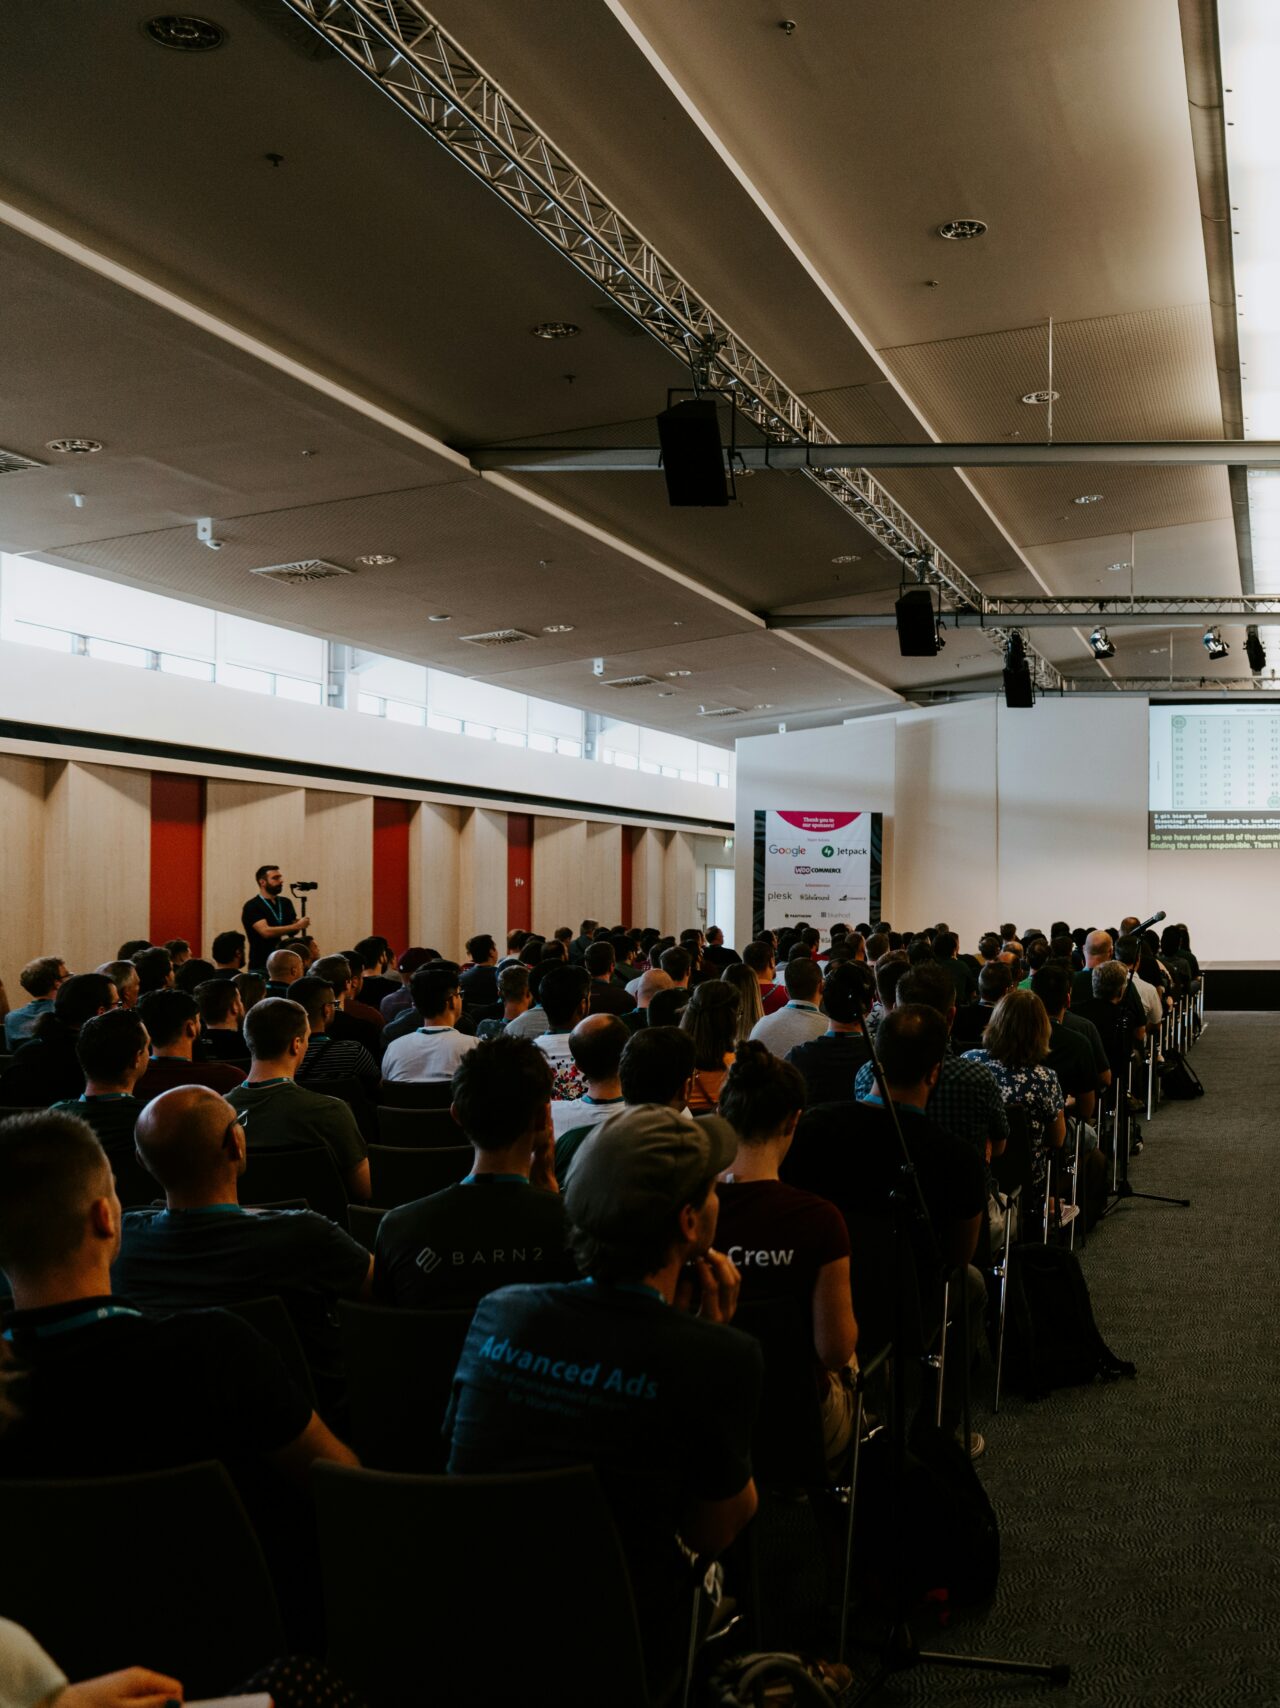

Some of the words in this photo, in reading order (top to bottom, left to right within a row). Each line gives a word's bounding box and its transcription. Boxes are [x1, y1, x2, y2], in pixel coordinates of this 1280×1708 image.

[768, 844, 806, 857] Google
[837, 847, 867, 856] Jetpack
[768, 892, 792, 901] plesk
[452, 1247, 544, 1266] BARN2
[727, 1245, 794, 1267] Crew
[478, 1335, 603, 1388] Advanced
[601, 1366, 659, 1400] Ads
